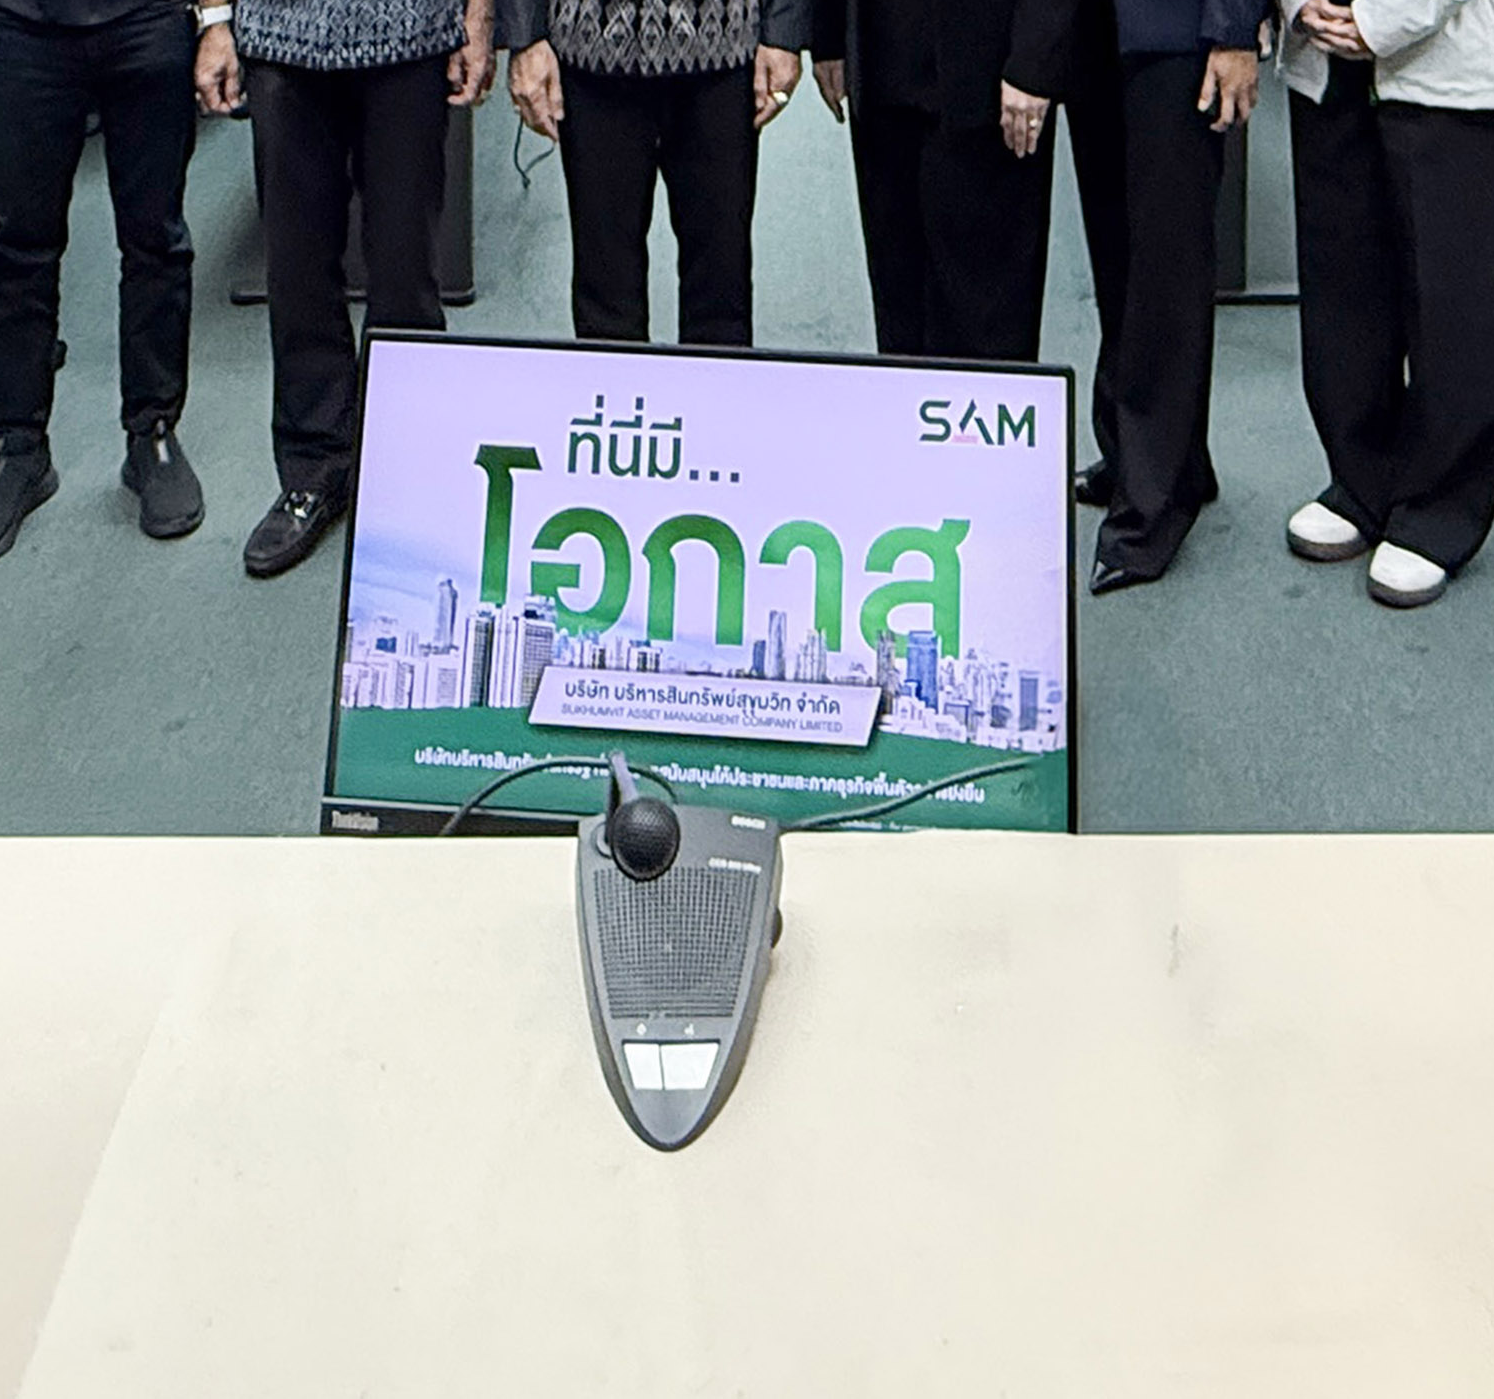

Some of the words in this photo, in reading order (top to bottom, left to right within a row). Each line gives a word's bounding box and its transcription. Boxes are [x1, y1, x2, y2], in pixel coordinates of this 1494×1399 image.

[567, 393, 741, 483] ที่นี่มี...
[918, 399, 1037, 448] SAM
[474, 444, 972, 660] โอกาส
[560, 703, 624, 718] SUKHUMVIT
[626, 706, 662, 720] ASSET
[663, 709, 741, 726] MANAGEMENT
[742, 713, 799, 731] COMPANY
[799, 719, 844, 734] LIMITED
[564, 679, 610, 699] บริษัท
[796, 691, 842, 715] จำกัด
